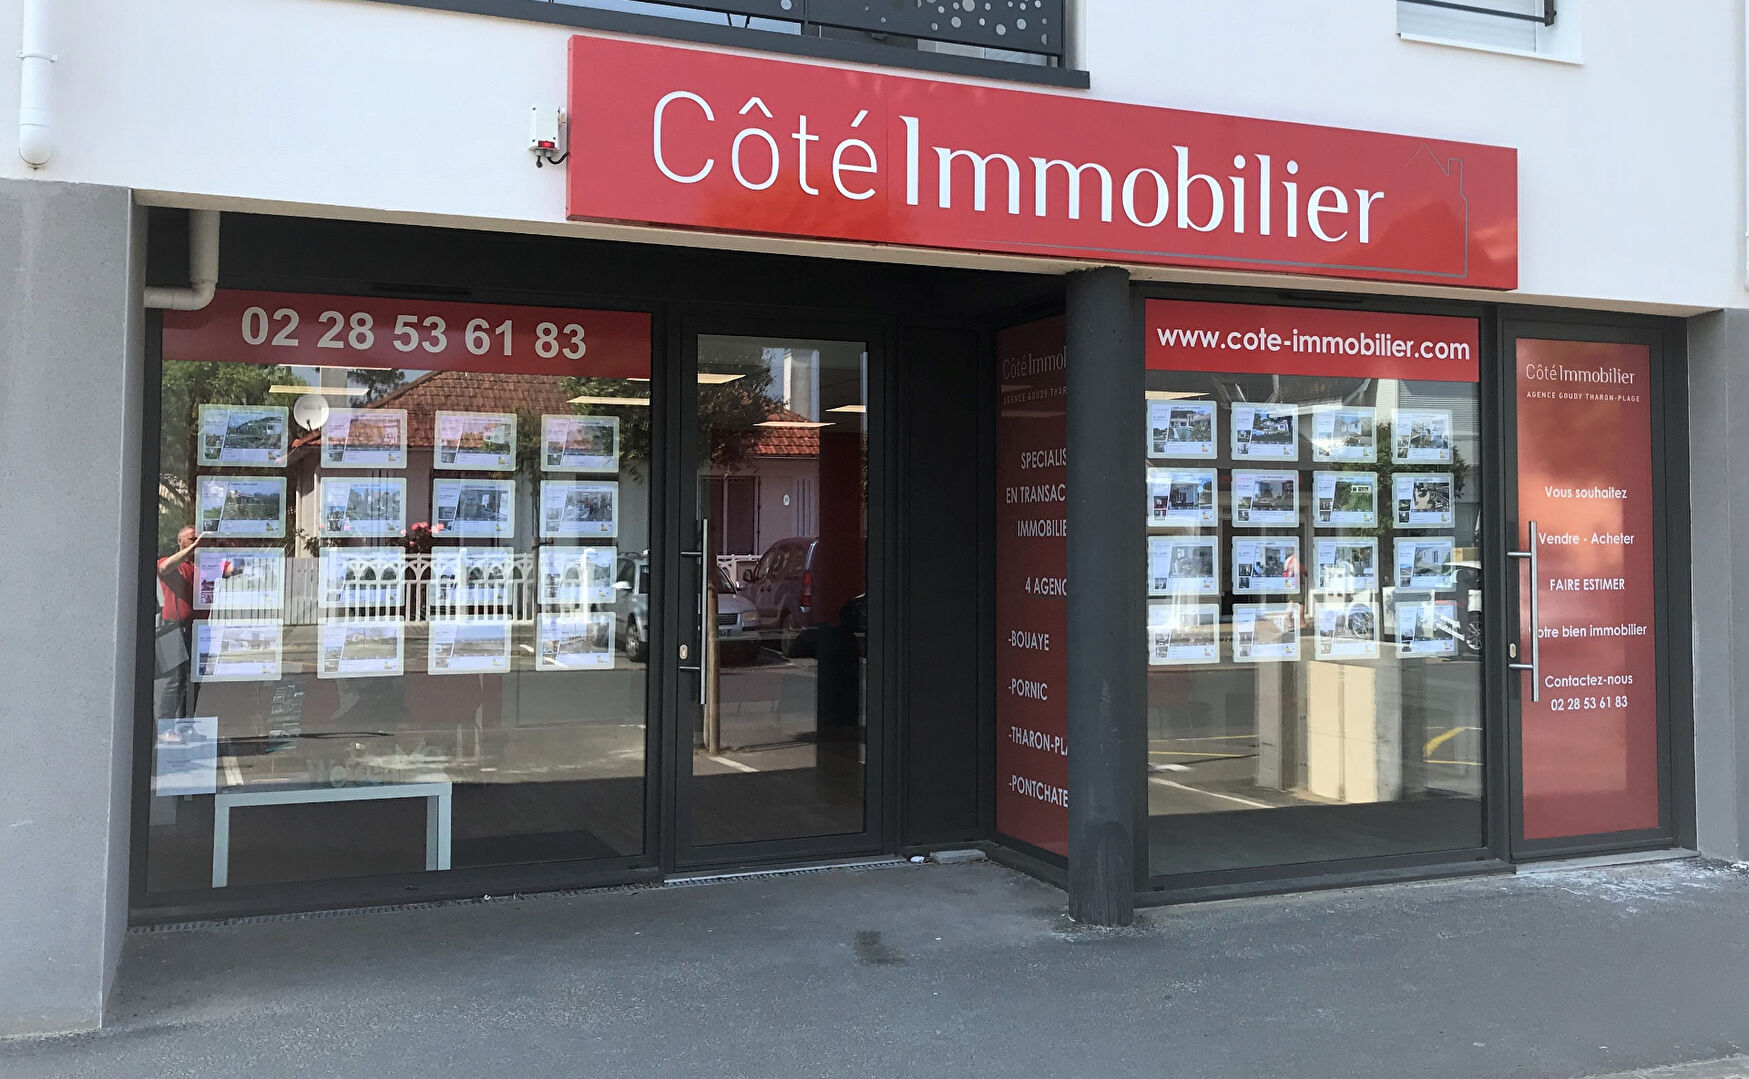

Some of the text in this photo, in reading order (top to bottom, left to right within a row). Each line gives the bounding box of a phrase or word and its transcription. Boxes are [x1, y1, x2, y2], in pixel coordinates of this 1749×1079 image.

[653, 90, 1385, 243] Côté Immobilier
[241, 306, 587, 360] 02 28 53 61 83
[1156, 326, 1470, 361] www.cote-immobilier.com
[1002, 353, 1027, 380] Côté
[1526, 363, 1635, 384] Côté Immobilier
[1526, 391, 1640, 402] AGENCE GOUDY THARON-PLAGE
[1006, 483, 1066, 504] EN TRANSAC
[1544, 486, 1628, 499] Vous souhaitez
[1538, 532, 1580, 545] Vendre
[1591, 532, 1635, 545] Acheter
[1025, 576, 1031, 594] 4
[1550, 578, 1625, 591] FAIRE ESTIMER
[1008, 630, 1050, 651] -BOUAYE
[1529, 624, 1647, 639] otre bien immobilier
[1008, 678, 1048, 701] -PORNIC
[1544, 673, 1633, 688] Contactez-nous
[1551, 695, 1628, 711] 02 28 53 61 83
[1008, 774, 1069, 808] -PONTCHATE
